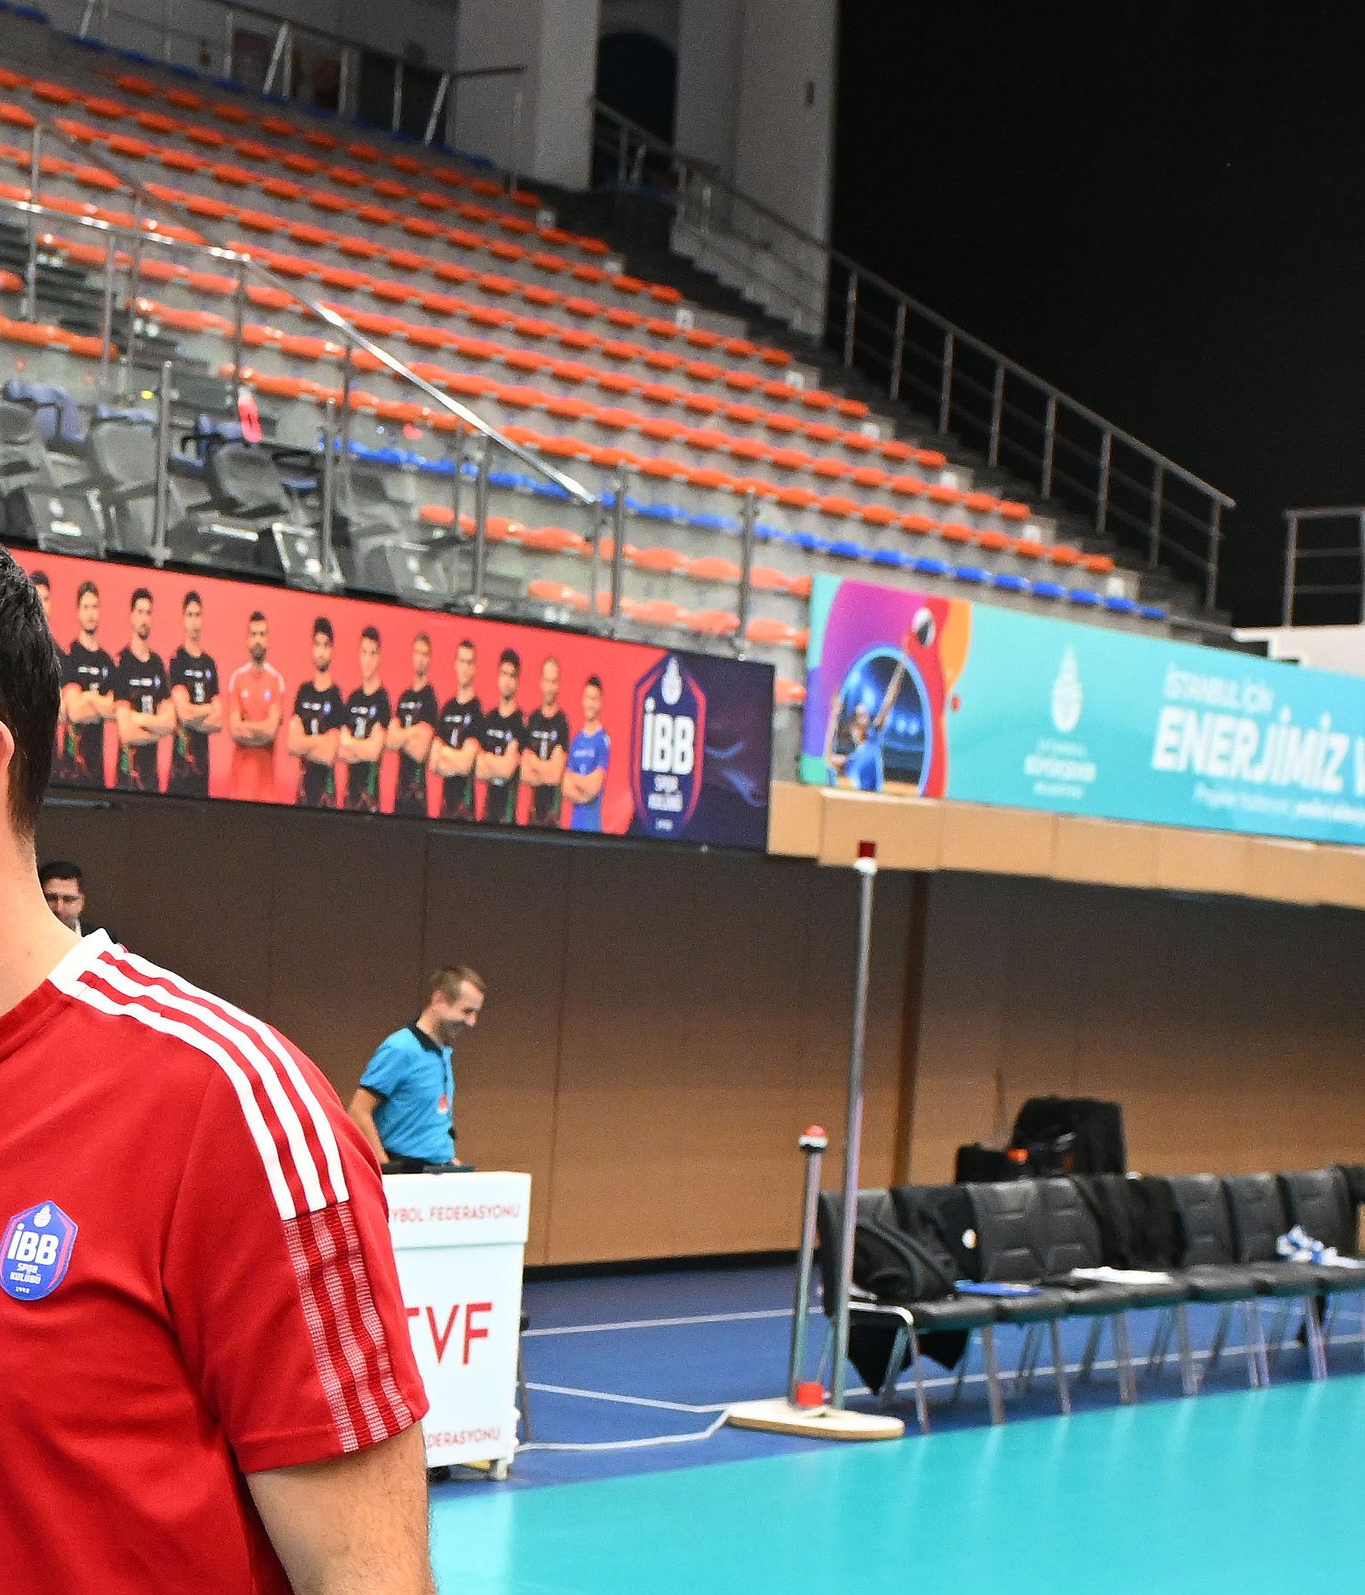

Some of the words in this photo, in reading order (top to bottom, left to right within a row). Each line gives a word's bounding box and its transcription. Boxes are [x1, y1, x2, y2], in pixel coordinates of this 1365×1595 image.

[642, 696, 696, 776] İBB
[1151, 703, 1350, 795] ENERJİMİZ
[429, 1203, 521, 1222] FEDERASYONU
[7, 1222, 59, 1266] İBB
